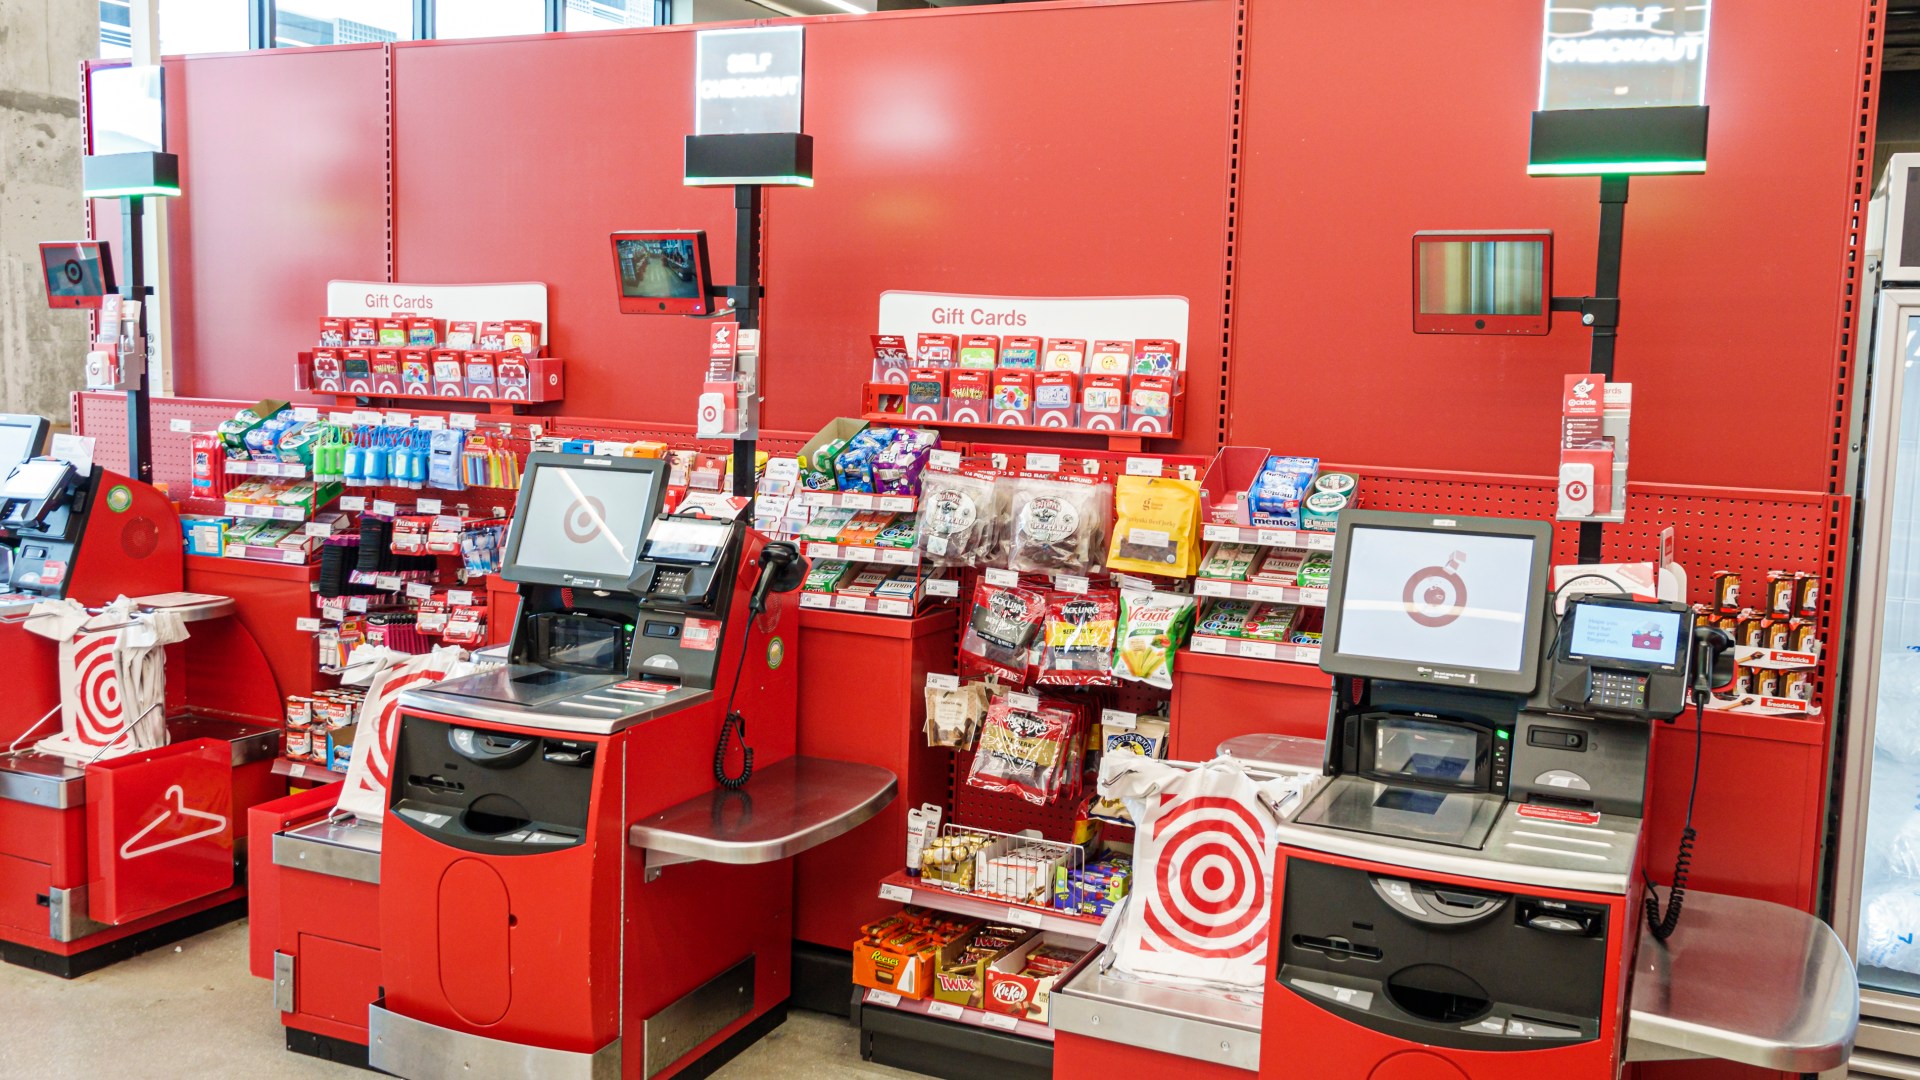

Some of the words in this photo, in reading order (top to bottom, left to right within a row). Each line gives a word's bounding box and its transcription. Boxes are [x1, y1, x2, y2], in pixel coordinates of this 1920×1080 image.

[1592, 6, 1662, 31] SELF
[1547, 36, 1704, 63] CHECKOUT
[727, 52, 773, 74] SELF
[701, 76, 800, 99] CHECKOUT
[365, 293, 389, 309] Gift
[393, 294, 433, 309] Cards
[931, 307, 965, 325] Gift
[970, 308, 1027, 327] Cards
[1604, 387, 1622, 395] ards
[769, 468, 785, 476] Google
[973, 472, 994, 481] POUND
[804, 477, 829, 490] Orbit
[1069, 476, 1093, 484] POUND
[757, 504, 772, 512] Google
[396, 519, 419, 528] TYLENOL
[1253, 517, 1297, 527] mentos
[882, 528, 912, 539] Orbit
[860, 573, 883, 581] ALTOID
[454, 608, 480, 617] TYLENOL
[1128, 606, 1175, 622] Veggie
[1211, 612, 1244, 623] Orbit
[1203, 620, 1237, 630] Orbit
[1776, 655, 1809, 664] Breadsticks
[1766, 701, 1800, 710] Breadsticks
[871, 950, 899, 966] Reese's
